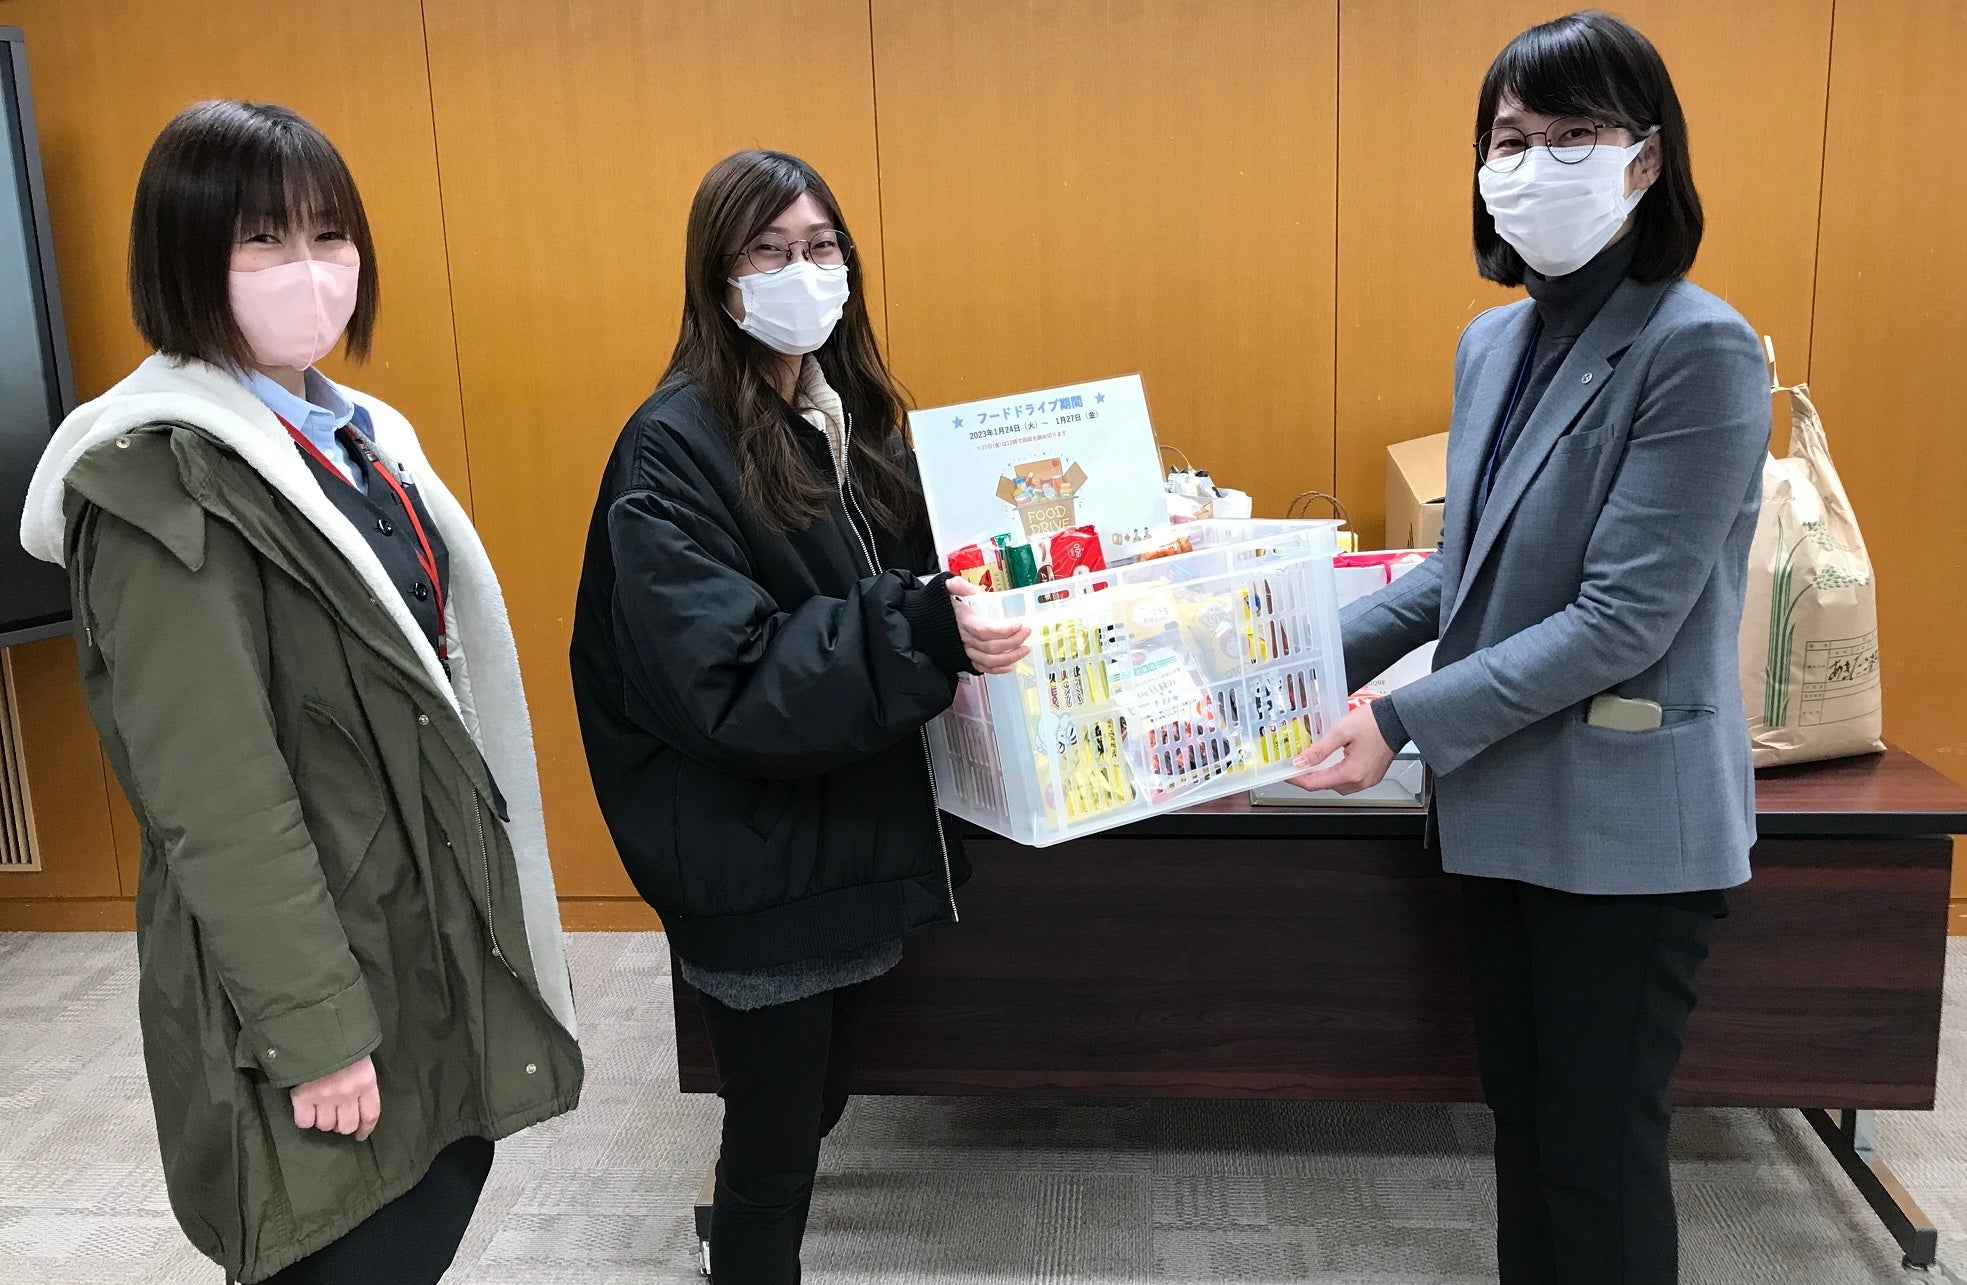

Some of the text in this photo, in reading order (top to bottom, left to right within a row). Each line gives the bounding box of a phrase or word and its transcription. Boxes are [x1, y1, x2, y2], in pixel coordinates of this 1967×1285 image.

[977, 395, 1083, 424] フードドライブ期間
[1027, 505, 1066, 523] FOOD
[1030, 518, 1070, 536] DRIVE
